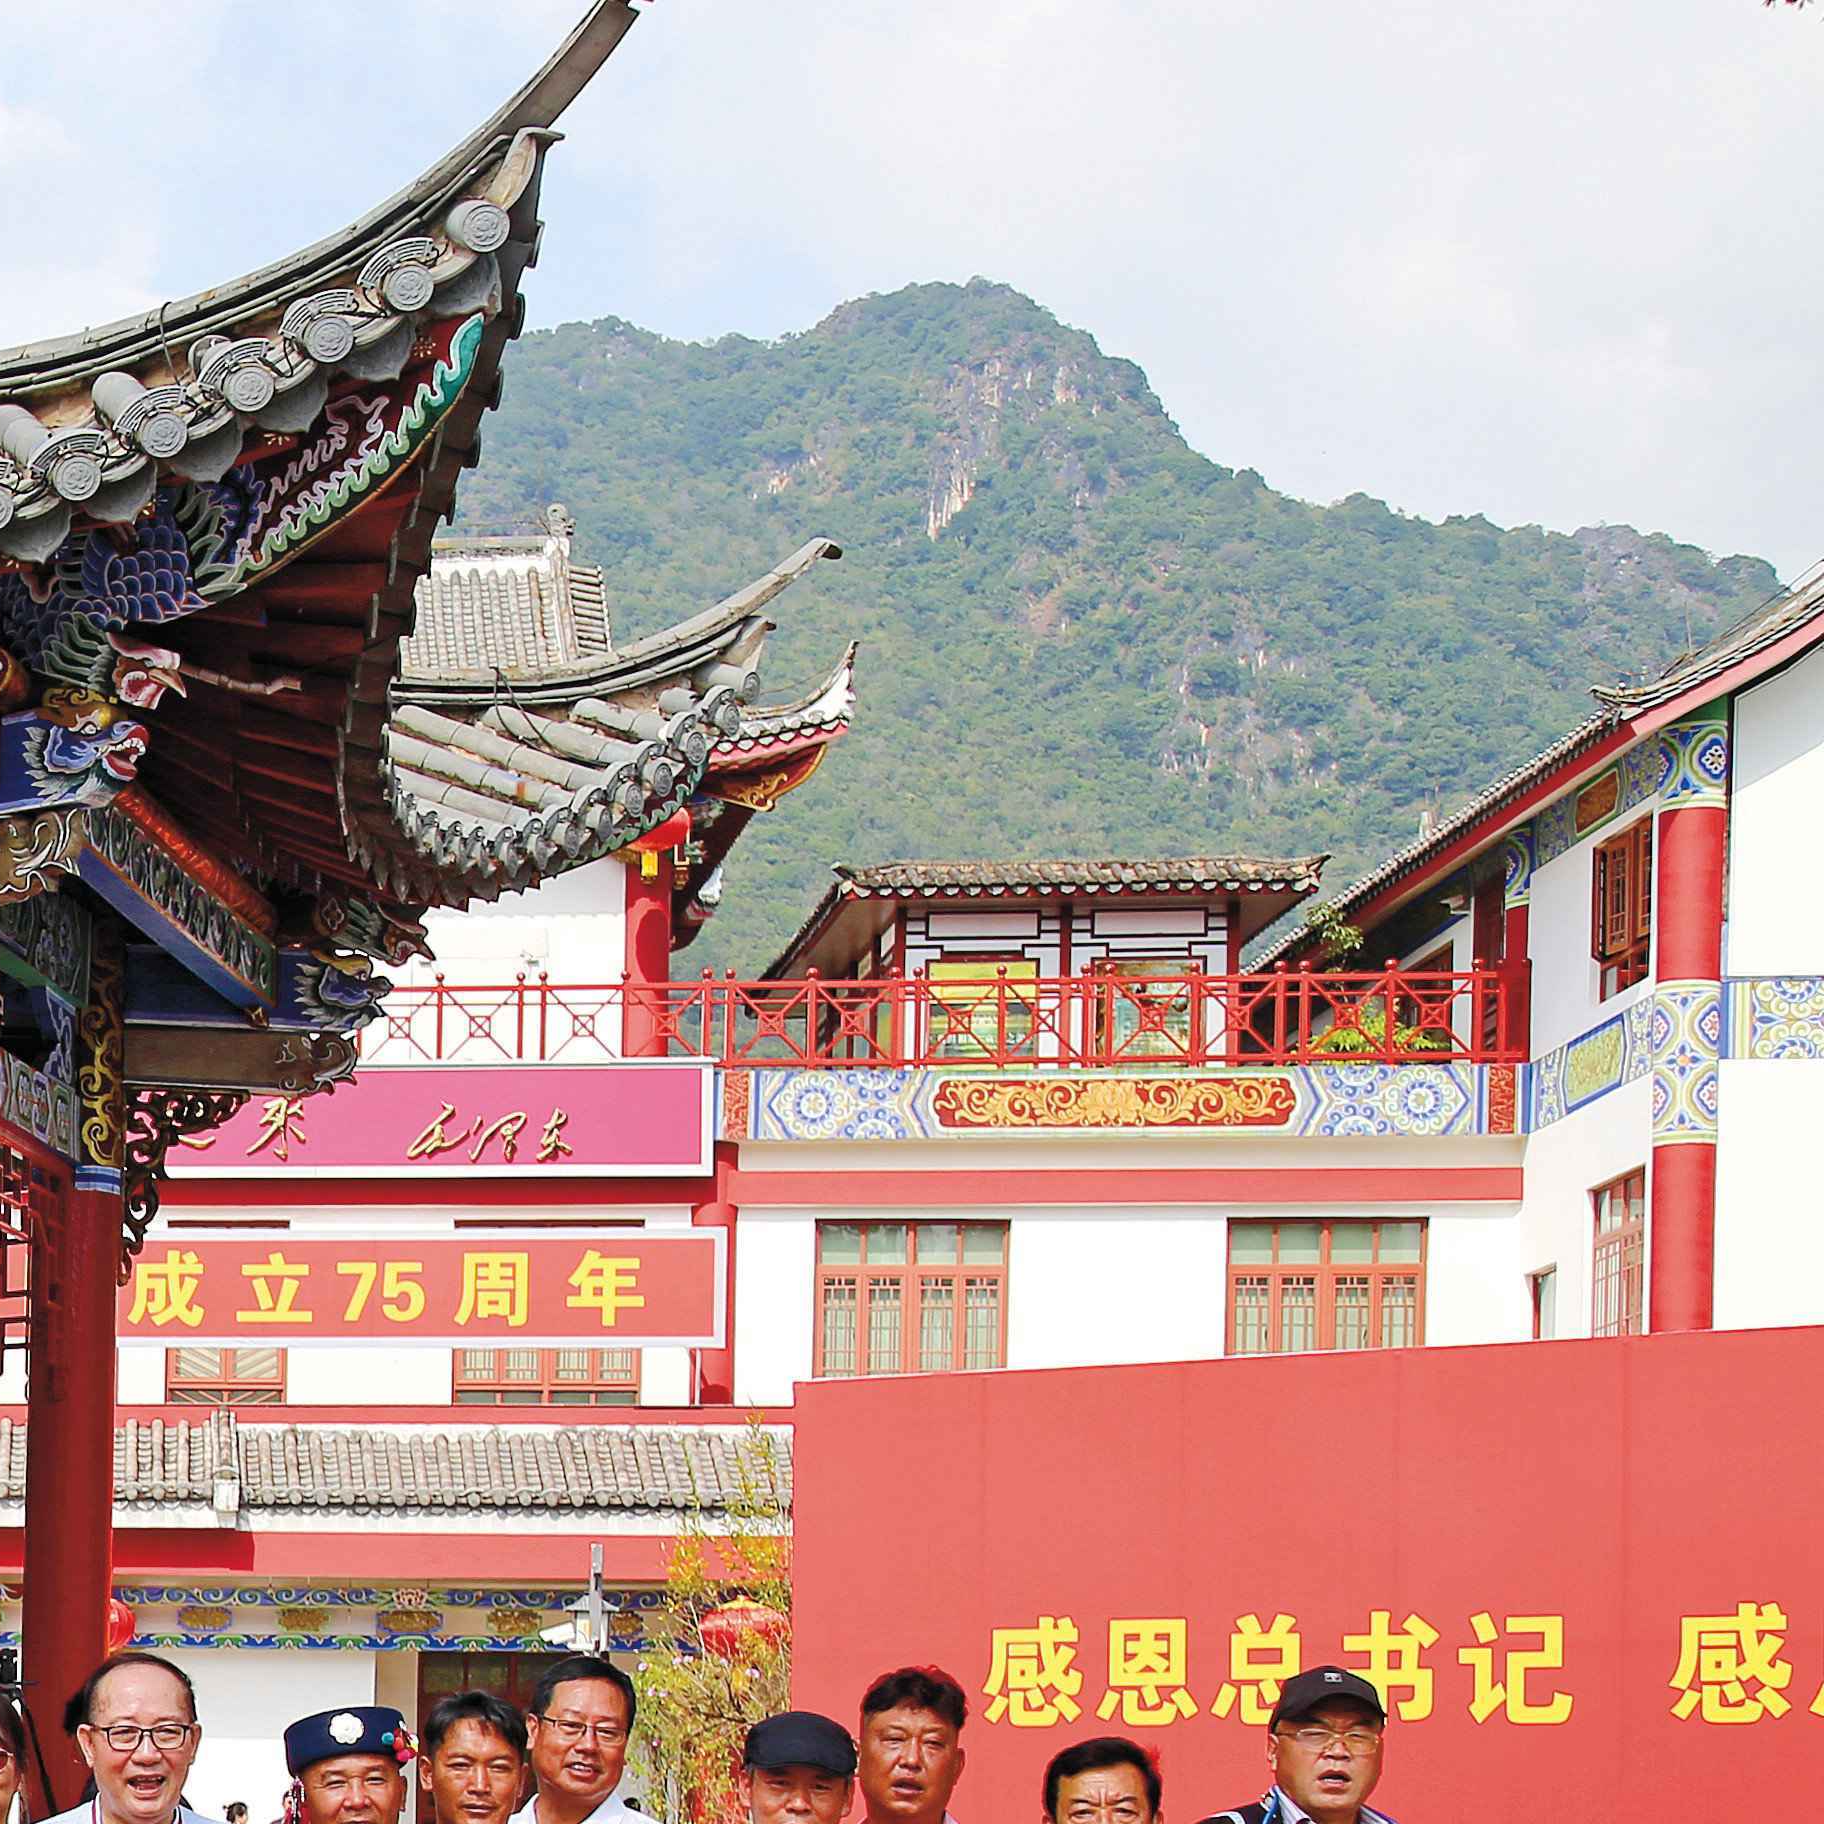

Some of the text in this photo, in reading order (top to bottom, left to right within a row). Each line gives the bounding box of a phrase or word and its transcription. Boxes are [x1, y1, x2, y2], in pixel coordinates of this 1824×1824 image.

[982, 1601, 1824, 1727] 感恩总书记 感
